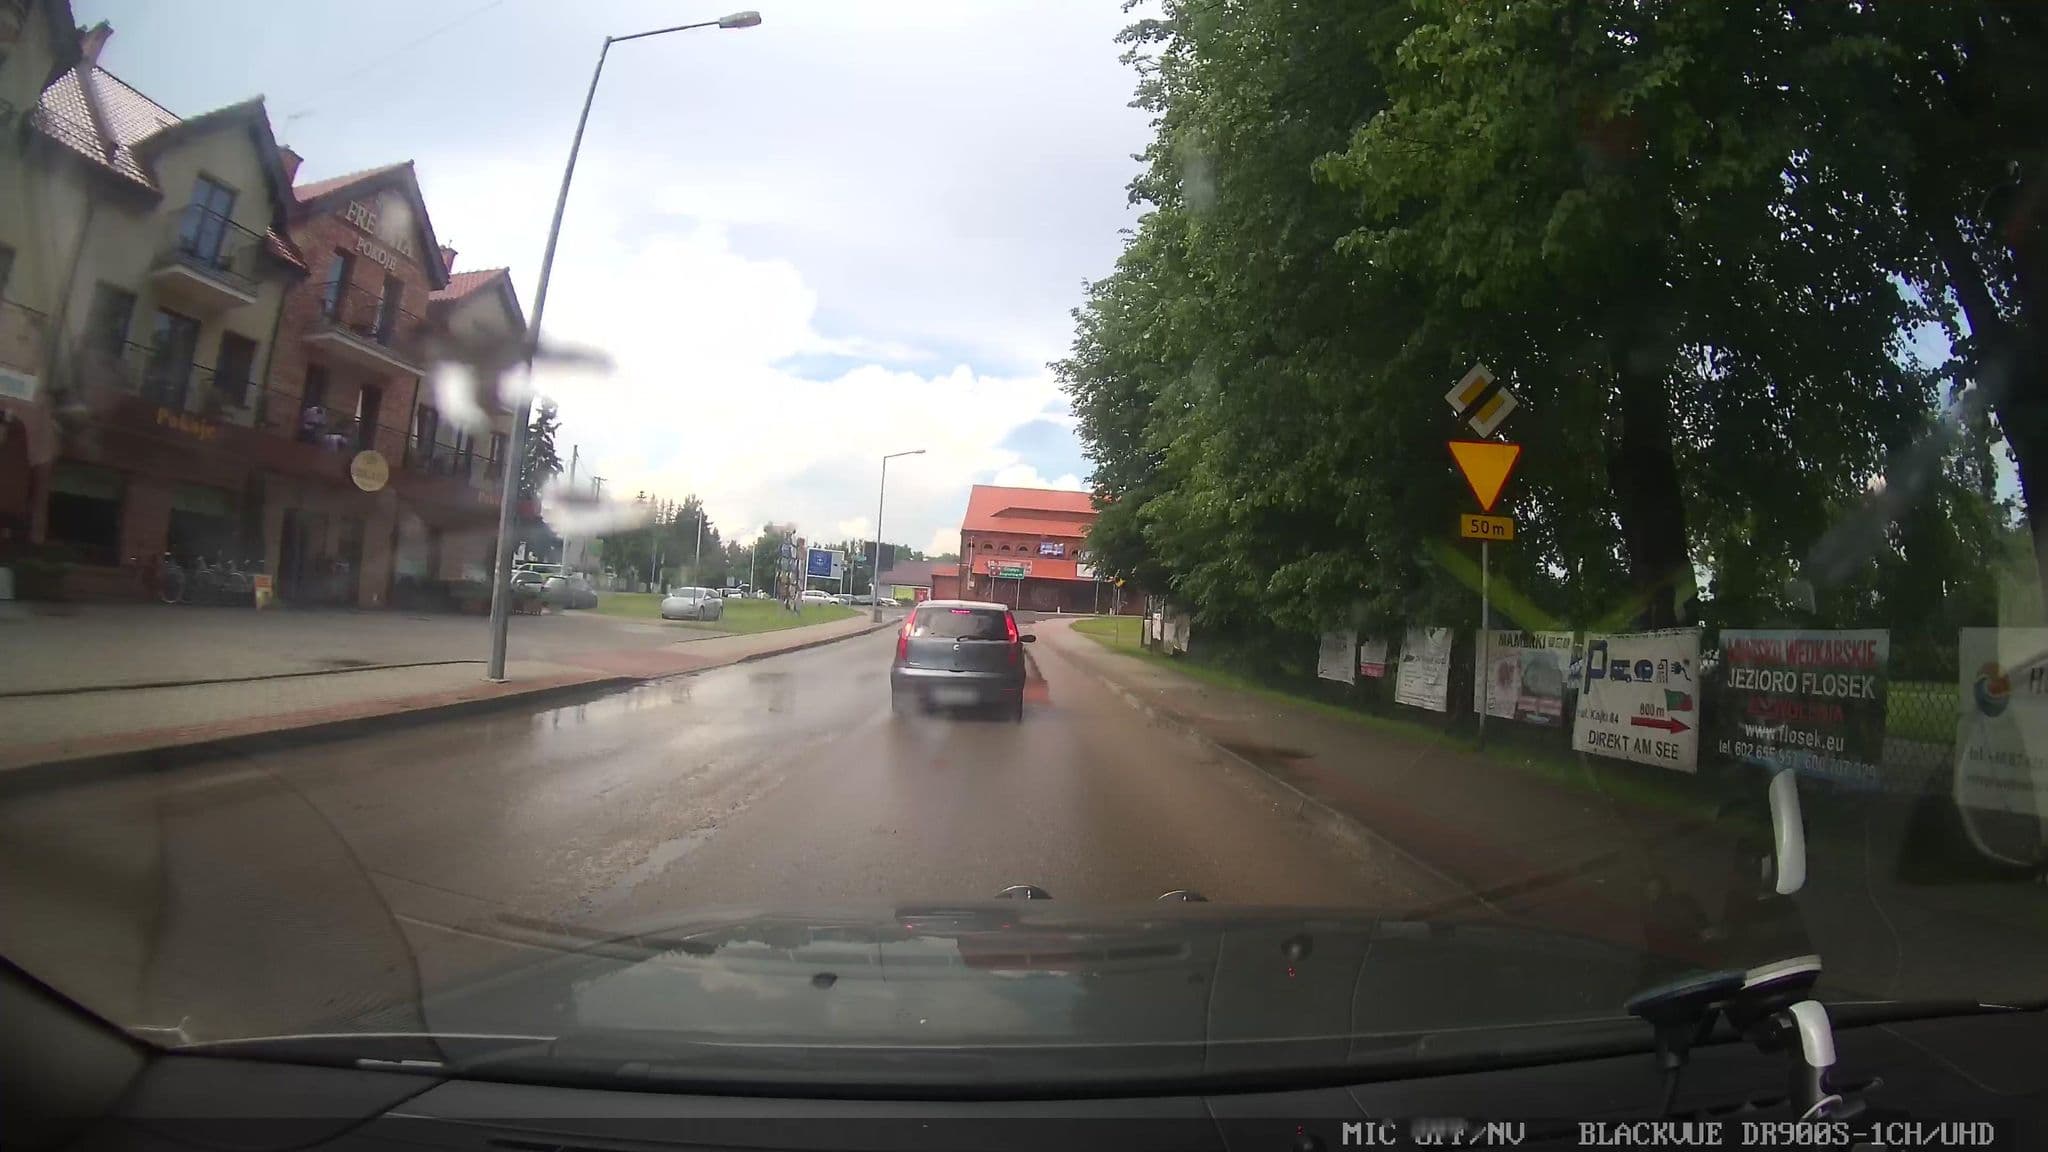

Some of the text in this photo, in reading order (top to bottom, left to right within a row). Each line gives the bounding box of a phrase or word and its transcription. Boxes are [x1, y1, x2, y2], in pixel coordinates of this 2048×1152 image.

[356, 237, 397, 270] POKOJE
[1471, 519, 1504, 535] 50 m
[1728, 668, 1876, 699] JEZIORO FLOSEK
[1588, 730, 1679, 760] DIREKT AM SEE
[1735, 741, 1753, 757] 602
[1745, 723, 1844, 752] www.flosek.eu
